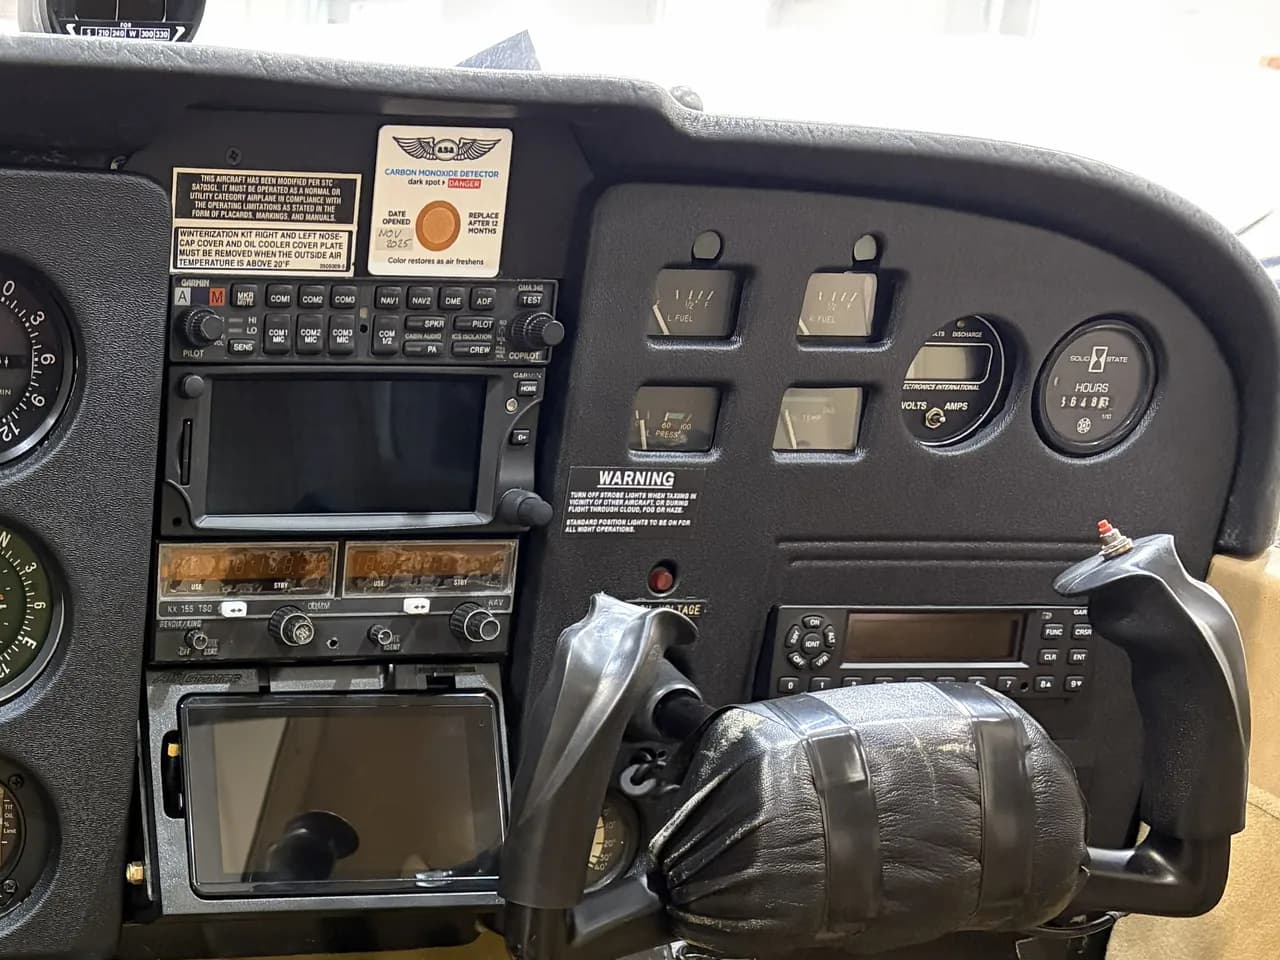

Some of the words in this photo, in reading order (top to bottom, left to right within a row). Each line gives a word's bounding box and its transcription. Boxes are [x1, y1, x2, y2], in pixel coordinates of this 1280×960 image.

[418, 169, 459, 177] MONOXIDE
[378, 229, 401, 238] NOV
[386, 239, 412, 248] 2025
[294, 251, 327, 259] OUTSIDE
[179, 259, 235, 267] TEMPERATURE
[271, 295, 290, 303] COM1
[509, 352, 539, 360] COPILOT
[1075, 383, 1108, 392] HOURS
[901, 401, 927, 410] VOLTS
[944, 402, 968, 410] AMPS
[599, 471, 675, 485] WARNING
